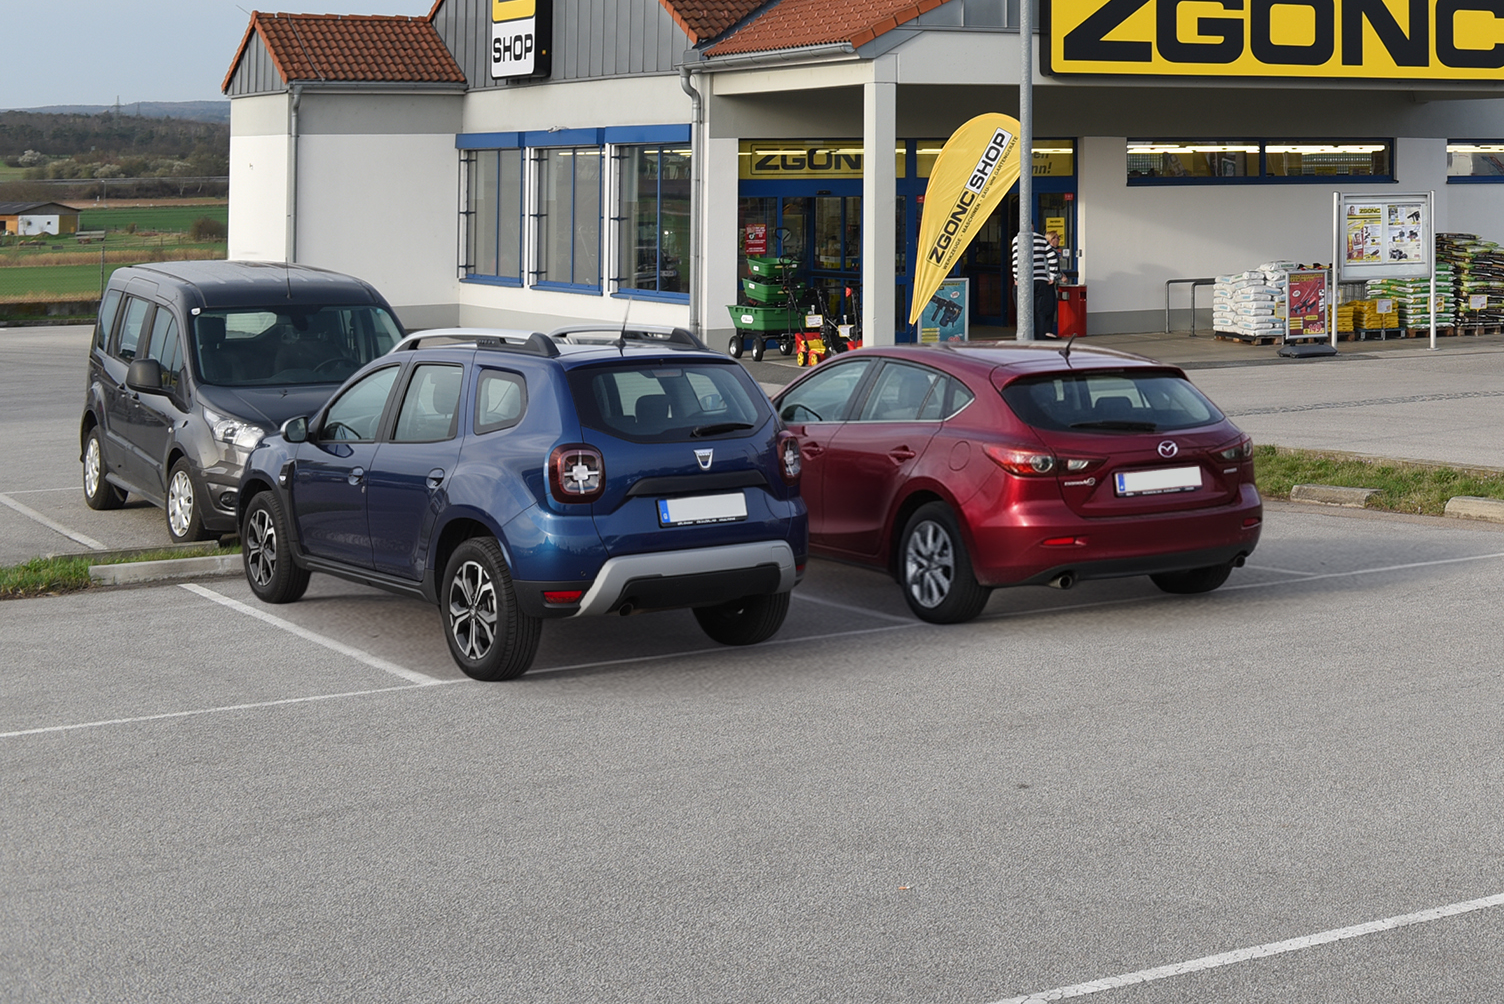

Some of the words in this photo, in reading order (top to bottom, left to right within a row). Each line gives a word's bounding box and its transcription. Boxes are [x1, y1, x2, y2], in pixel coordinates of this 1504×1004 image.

[492, 33, 533, 64] SHOP
[755, 148, 862, 171] ZGON
[929, 191, 976, 264] ZGONC
[969, 132, 1006, 190] SHOP
[943, 238, 962, 270] WERKZEUGE
[962, 202, 981, 234] MASCHINEN
